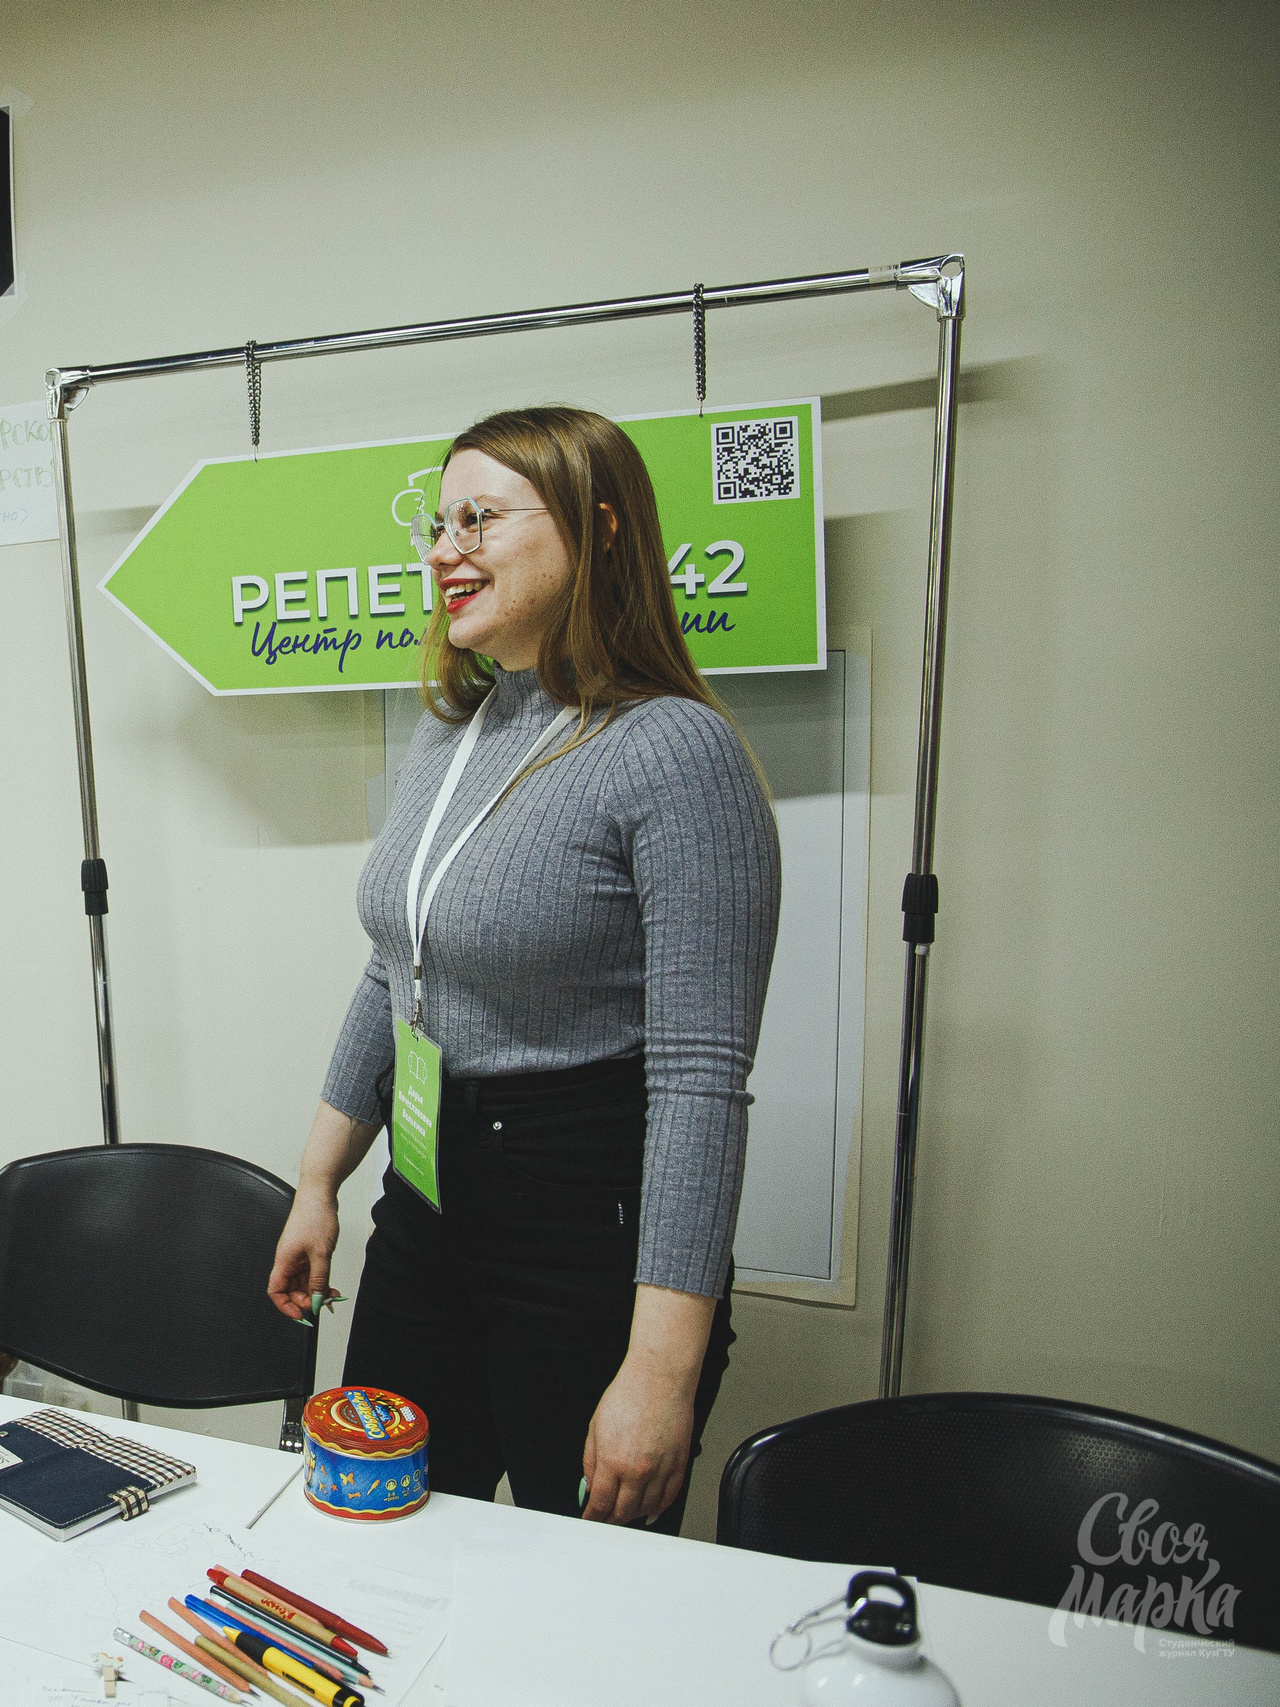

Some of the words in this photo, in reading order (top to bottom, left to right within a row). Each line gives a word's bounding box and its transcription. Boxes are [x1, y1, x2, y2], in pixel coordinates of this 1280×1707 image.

[232, 562, 434, 625] РЕПЕТ
[251, 621, 362, 673] Центр
[376, 628, 421, 650] по
